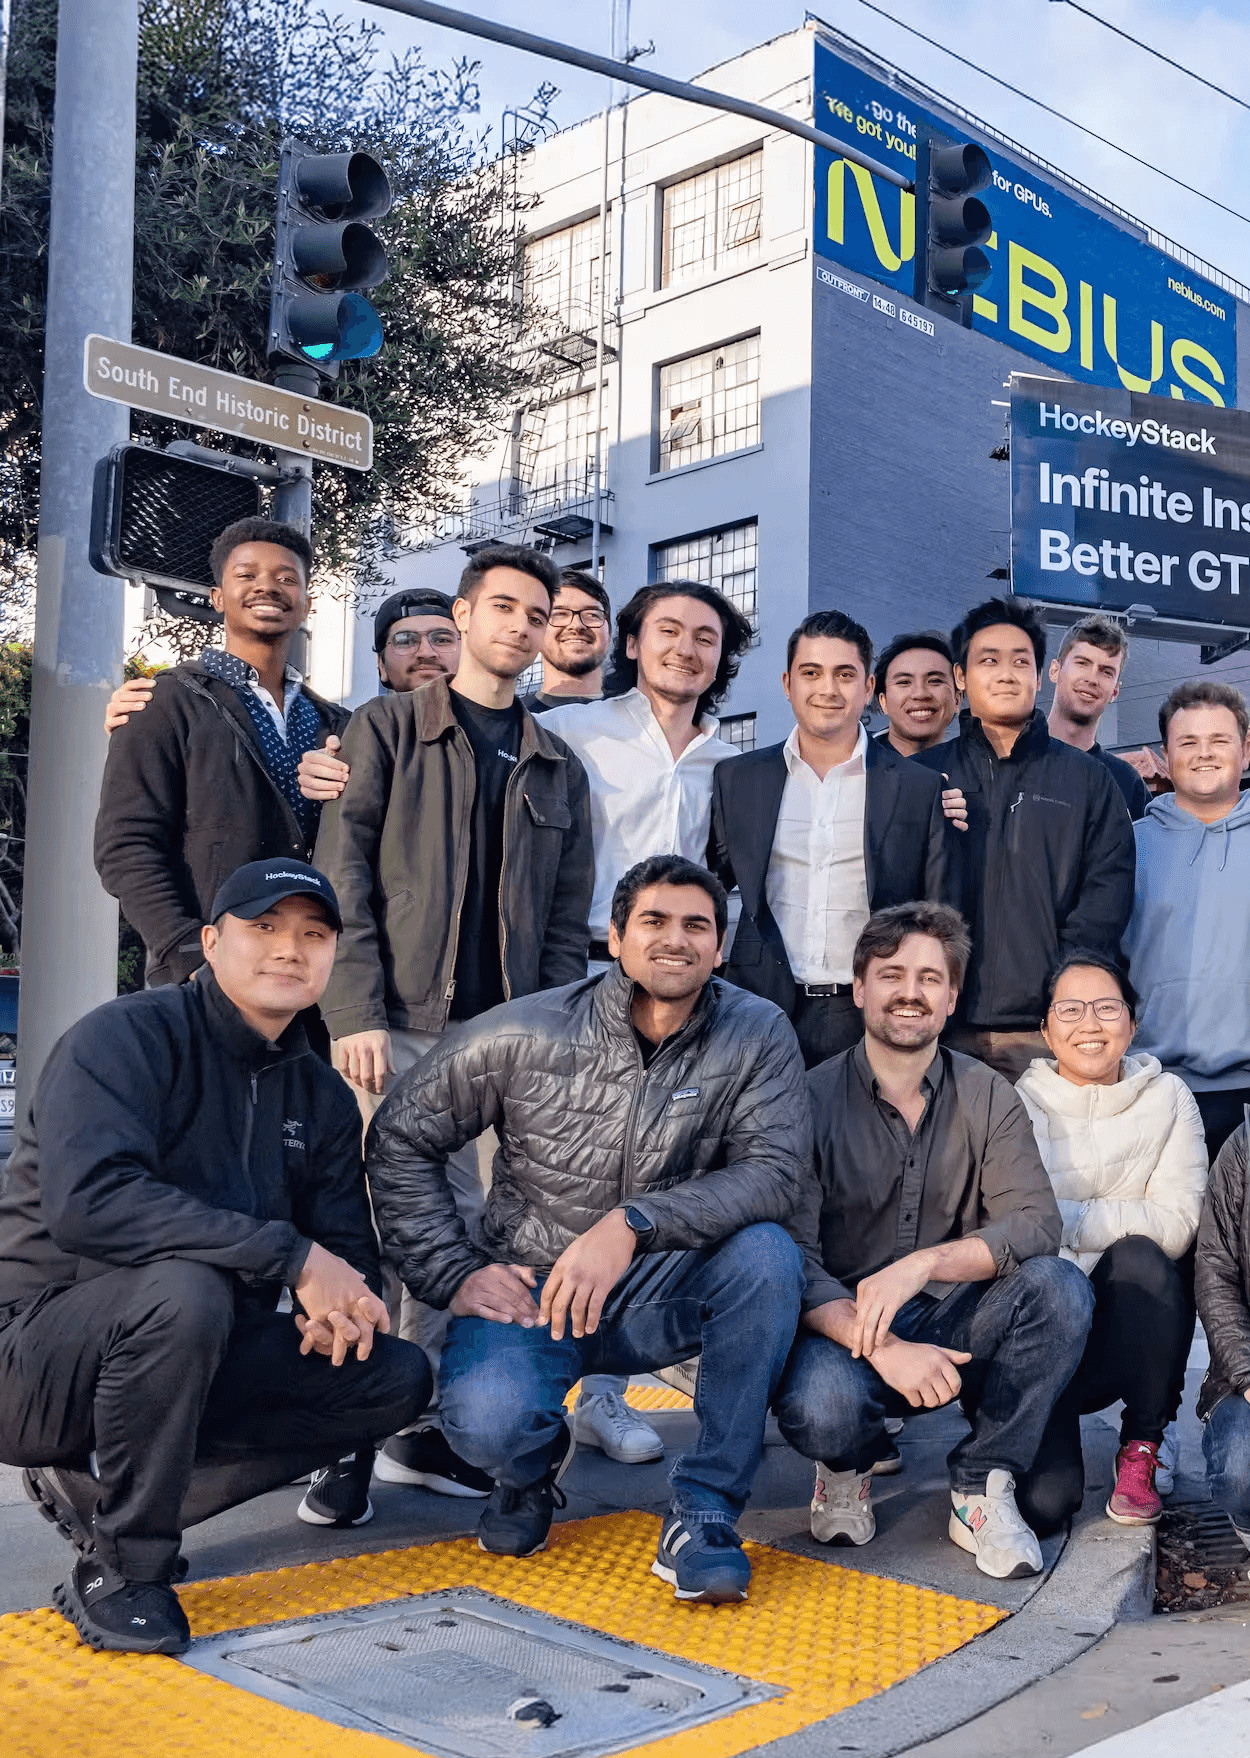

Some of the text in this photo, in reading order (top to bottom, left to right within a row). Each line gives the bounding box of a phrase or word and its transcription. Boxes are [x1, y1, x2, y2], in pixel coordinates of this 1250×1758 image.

[856, 115, 882, 141] got
[992, 170, 1012, 193] for
[1014, 183, 1053, 218] GPUs.
[821, 271, 866, 299] OUTFRONT
[827, 158, 1226, 409] NBIUS
[1167, 277, 1226, 321] nebius.com
[901, 311, 933, 334] 645197
[97, 356, 364, 452] South End Historic District
[1039, 402, 1217, 456] HockeyStack
[1039, 462, 1194, 523] Infinite
[1039, 528, 1180, 586] Better
[265, 871, 321, 887] HockeyStack
